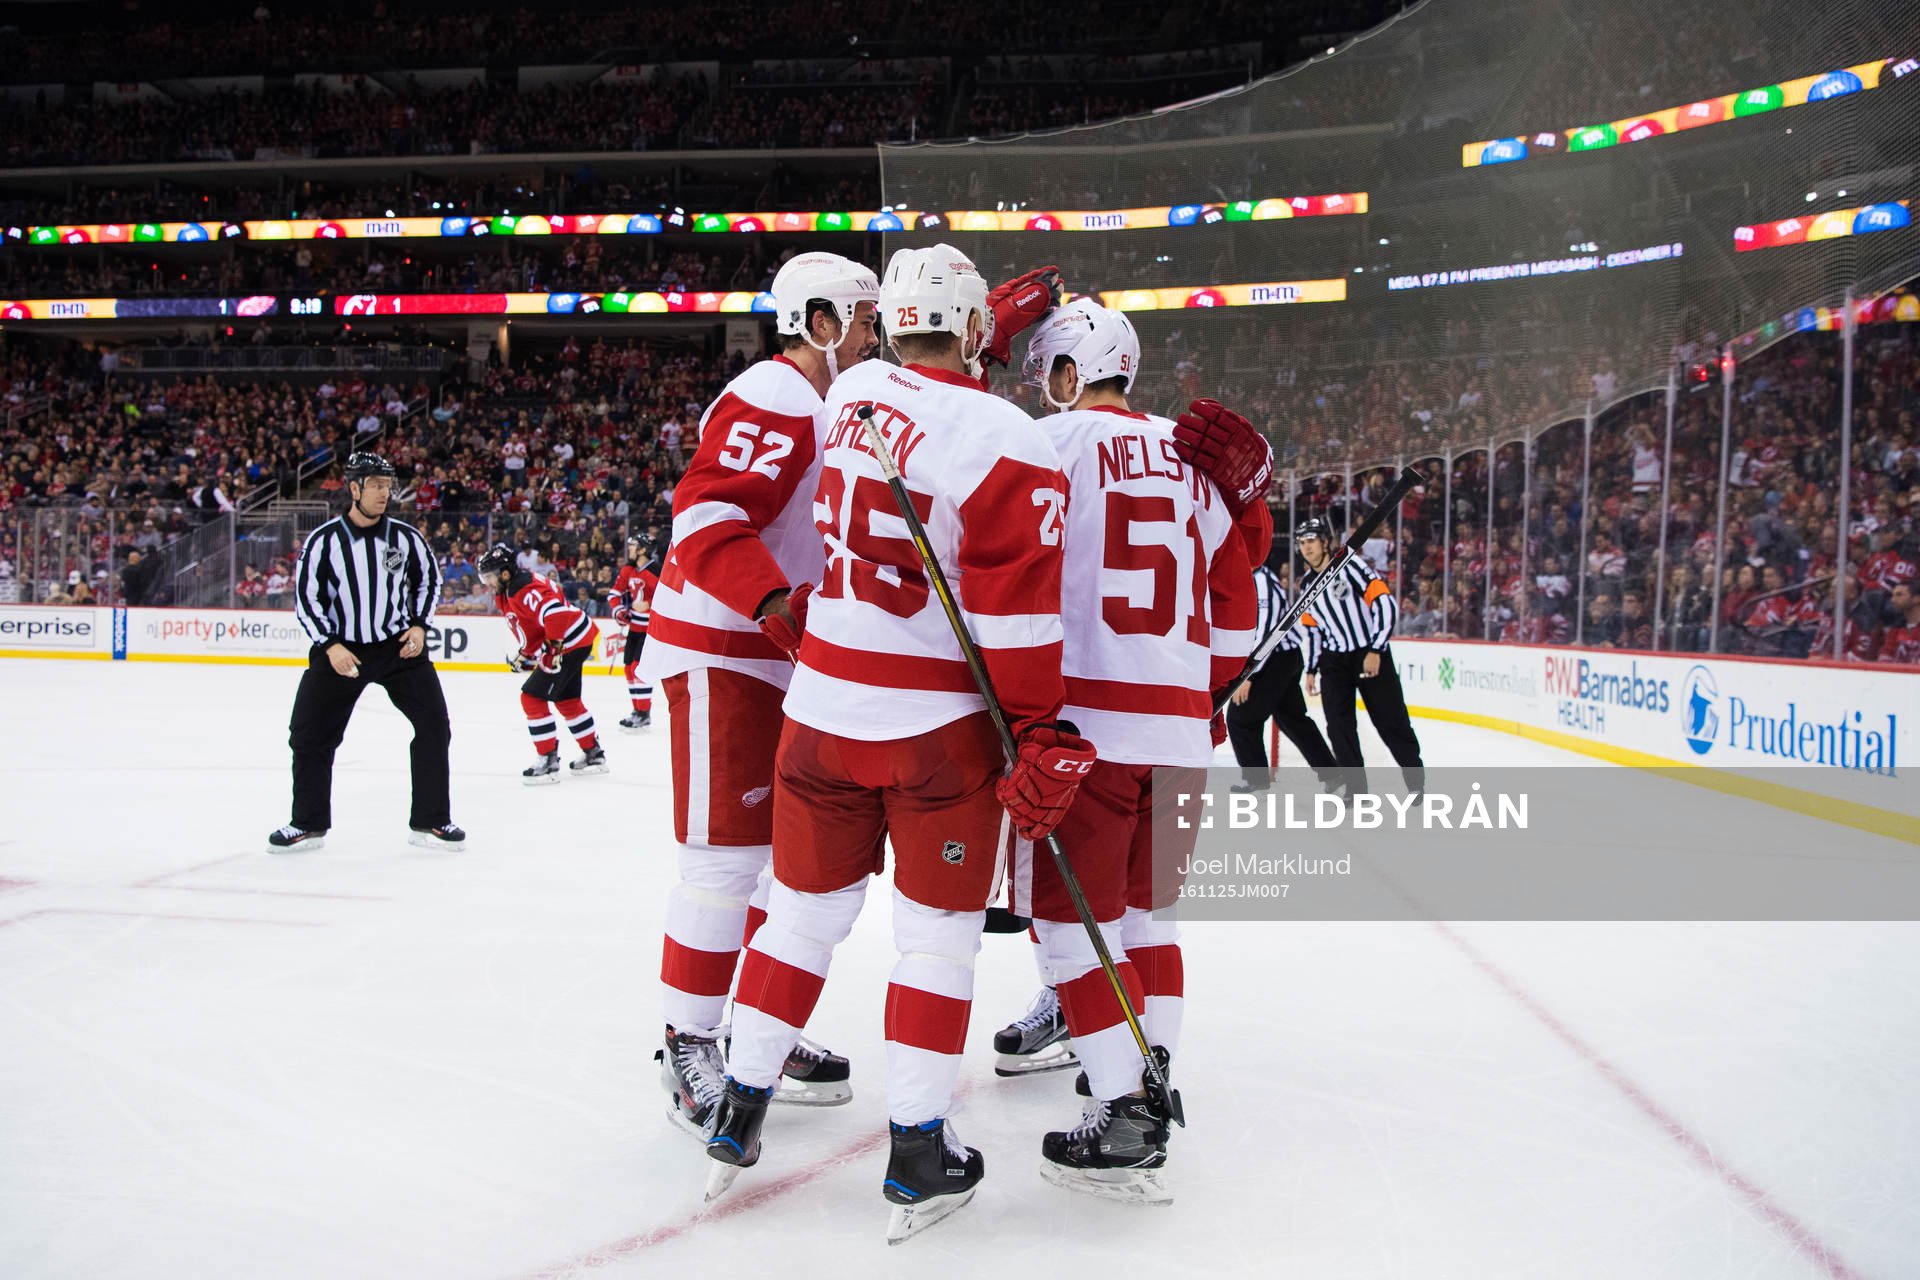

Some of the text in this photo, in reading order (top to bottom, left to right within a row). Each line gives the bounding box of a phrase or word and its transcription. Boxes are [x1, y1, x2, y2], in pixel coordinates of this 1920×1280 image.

[1450, 270, 1469, 283] FM
[1470, 263, 1530, 281] PRESENTS
[1607, 244, 1672, 268] DECEMBER
[218, 299, 227, 314] 1
[392, 297, 400, 313] 1
[1016, 289, 1042, 309] Reebok
[898, 306, 919, 327] 25
[1120, 354, 1131, 372] 51
[887, 372, 924, 392] Reebok
[718, 421, 795, 481] 52
[1097, 435, 1211, 511] NIELSN
[1102, 491, 1211, 648] 51
[523, 589, 543, 612] 21
[0, 617, 91, 639] erprise
[1545, 656, 1669, 713] RWJBarnabas
[1558, 699, 1605, 734] HEALTH
[1729, 696, 1898, 778] Prudential
